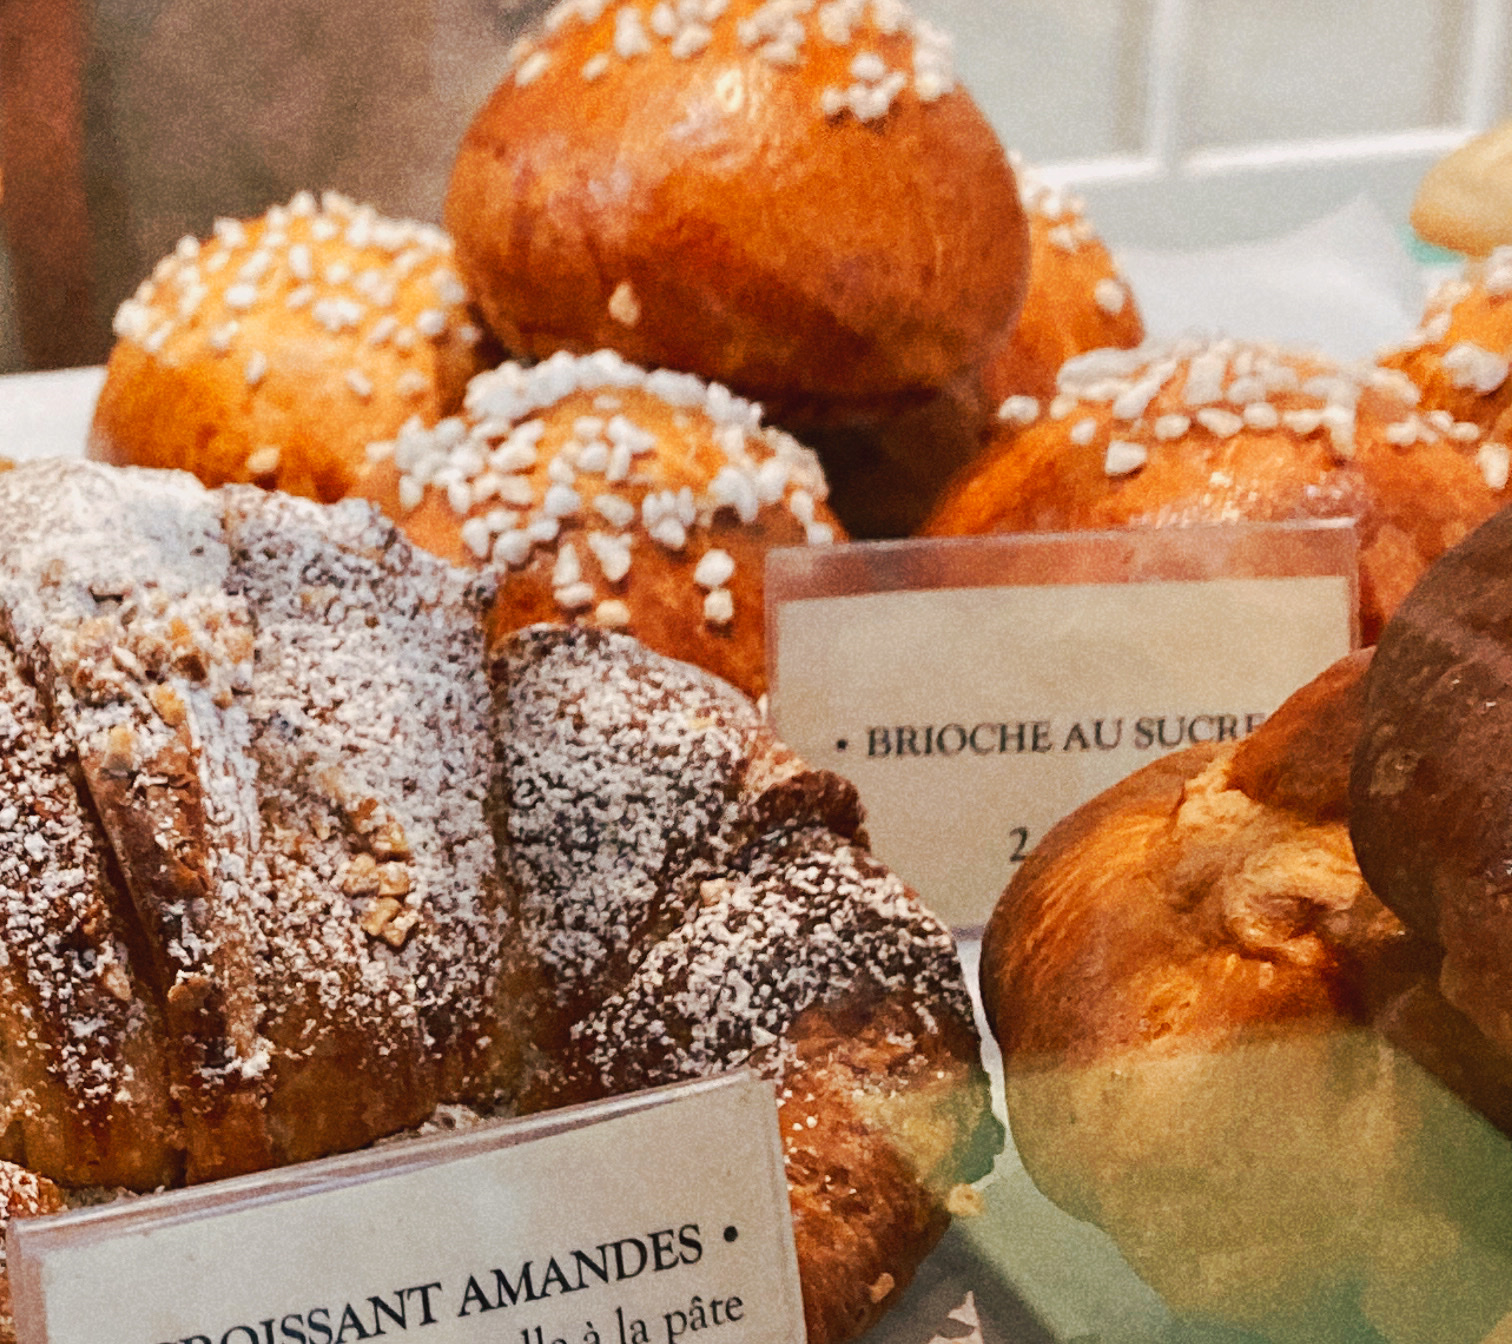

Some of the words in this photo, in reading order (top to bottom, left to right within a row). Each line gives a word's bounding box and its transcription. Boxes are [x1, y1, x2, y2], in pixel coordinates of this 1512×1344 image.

[867, 721, 1053, 757] BRIOCHE
[1062, 717, 1122, 752] AU
[456, 1223, 704, 1319] AMANDES
